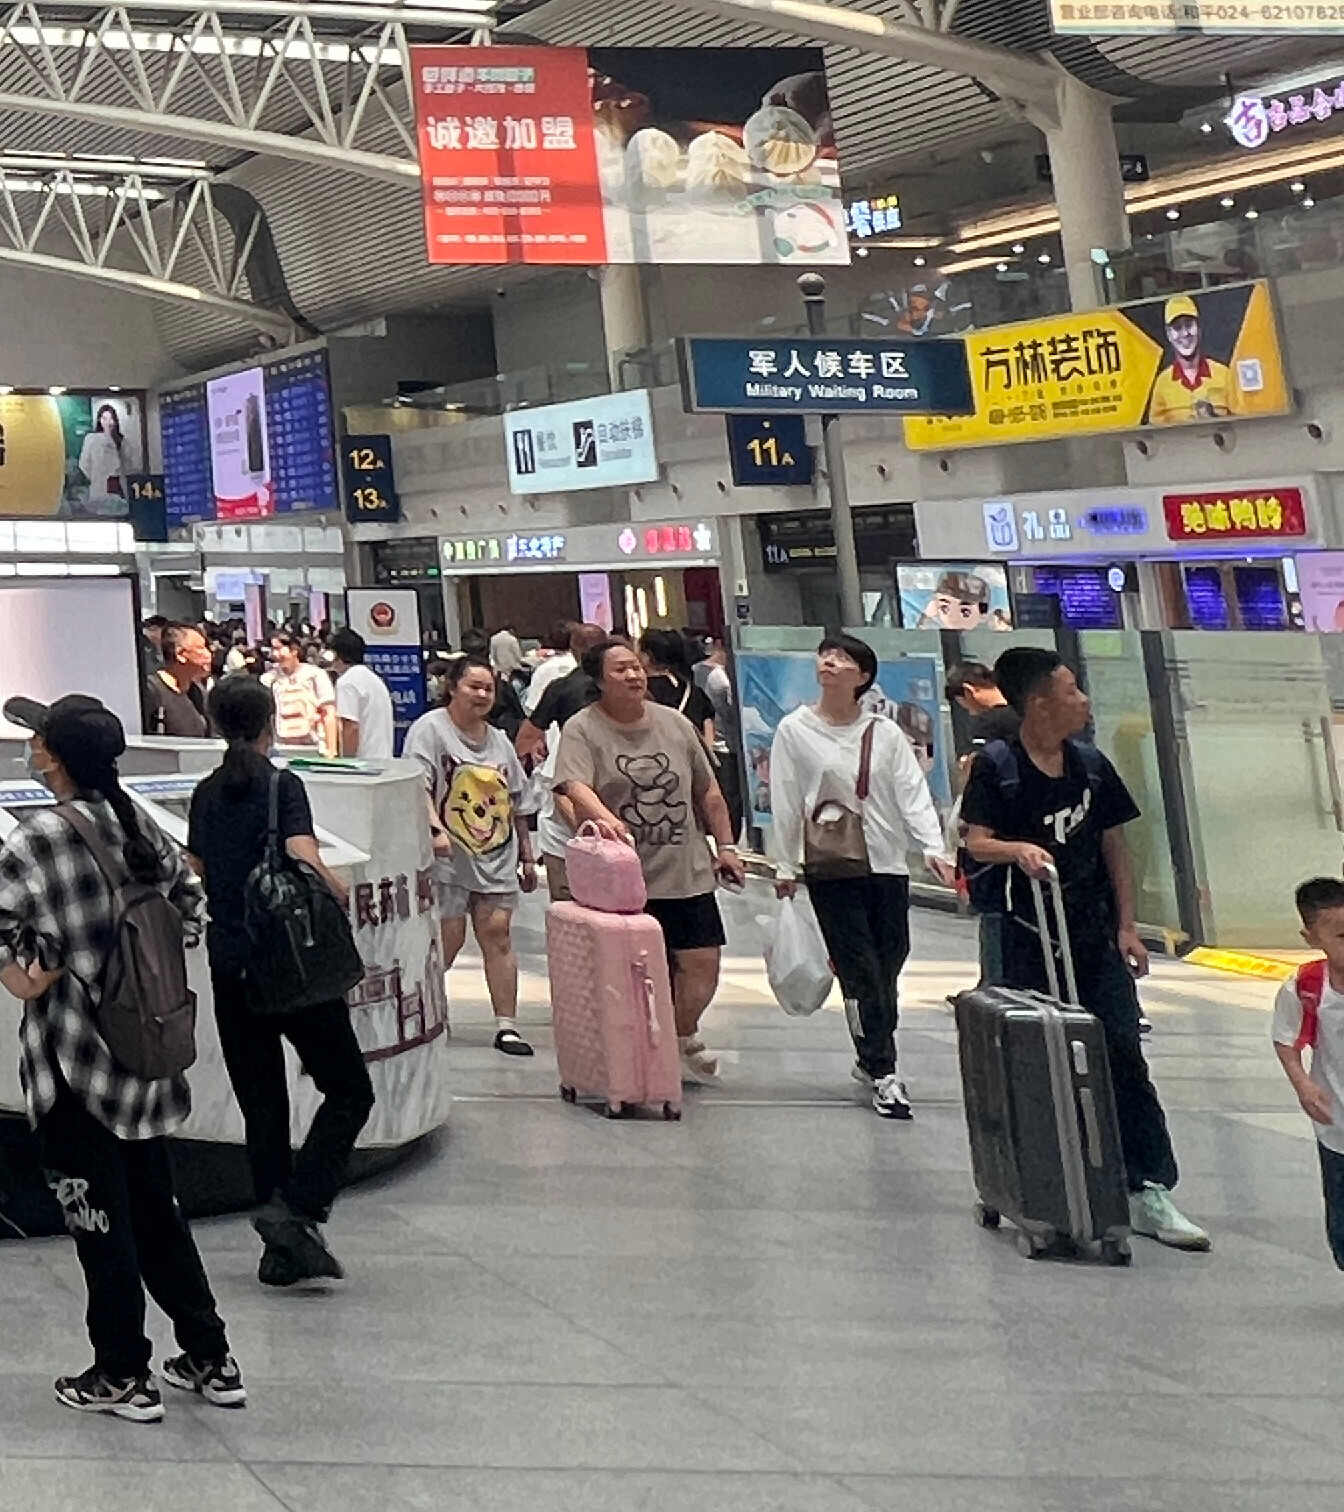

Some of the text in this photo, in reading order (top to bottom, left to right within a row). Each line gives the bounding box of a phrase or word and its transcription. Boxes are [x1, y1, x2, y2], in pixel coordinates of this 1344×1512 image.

[426, 116, 577, 150] 诚邀加盟
[748, 349, 910, 379] 军人候车区
[979, 328, 1122, 394] 方林装饰
[746, 382, 918, 403] Military Waiting Room
[745, 436, 795, 468] 11A
[1022, 508, 1072, 540] 礼品
